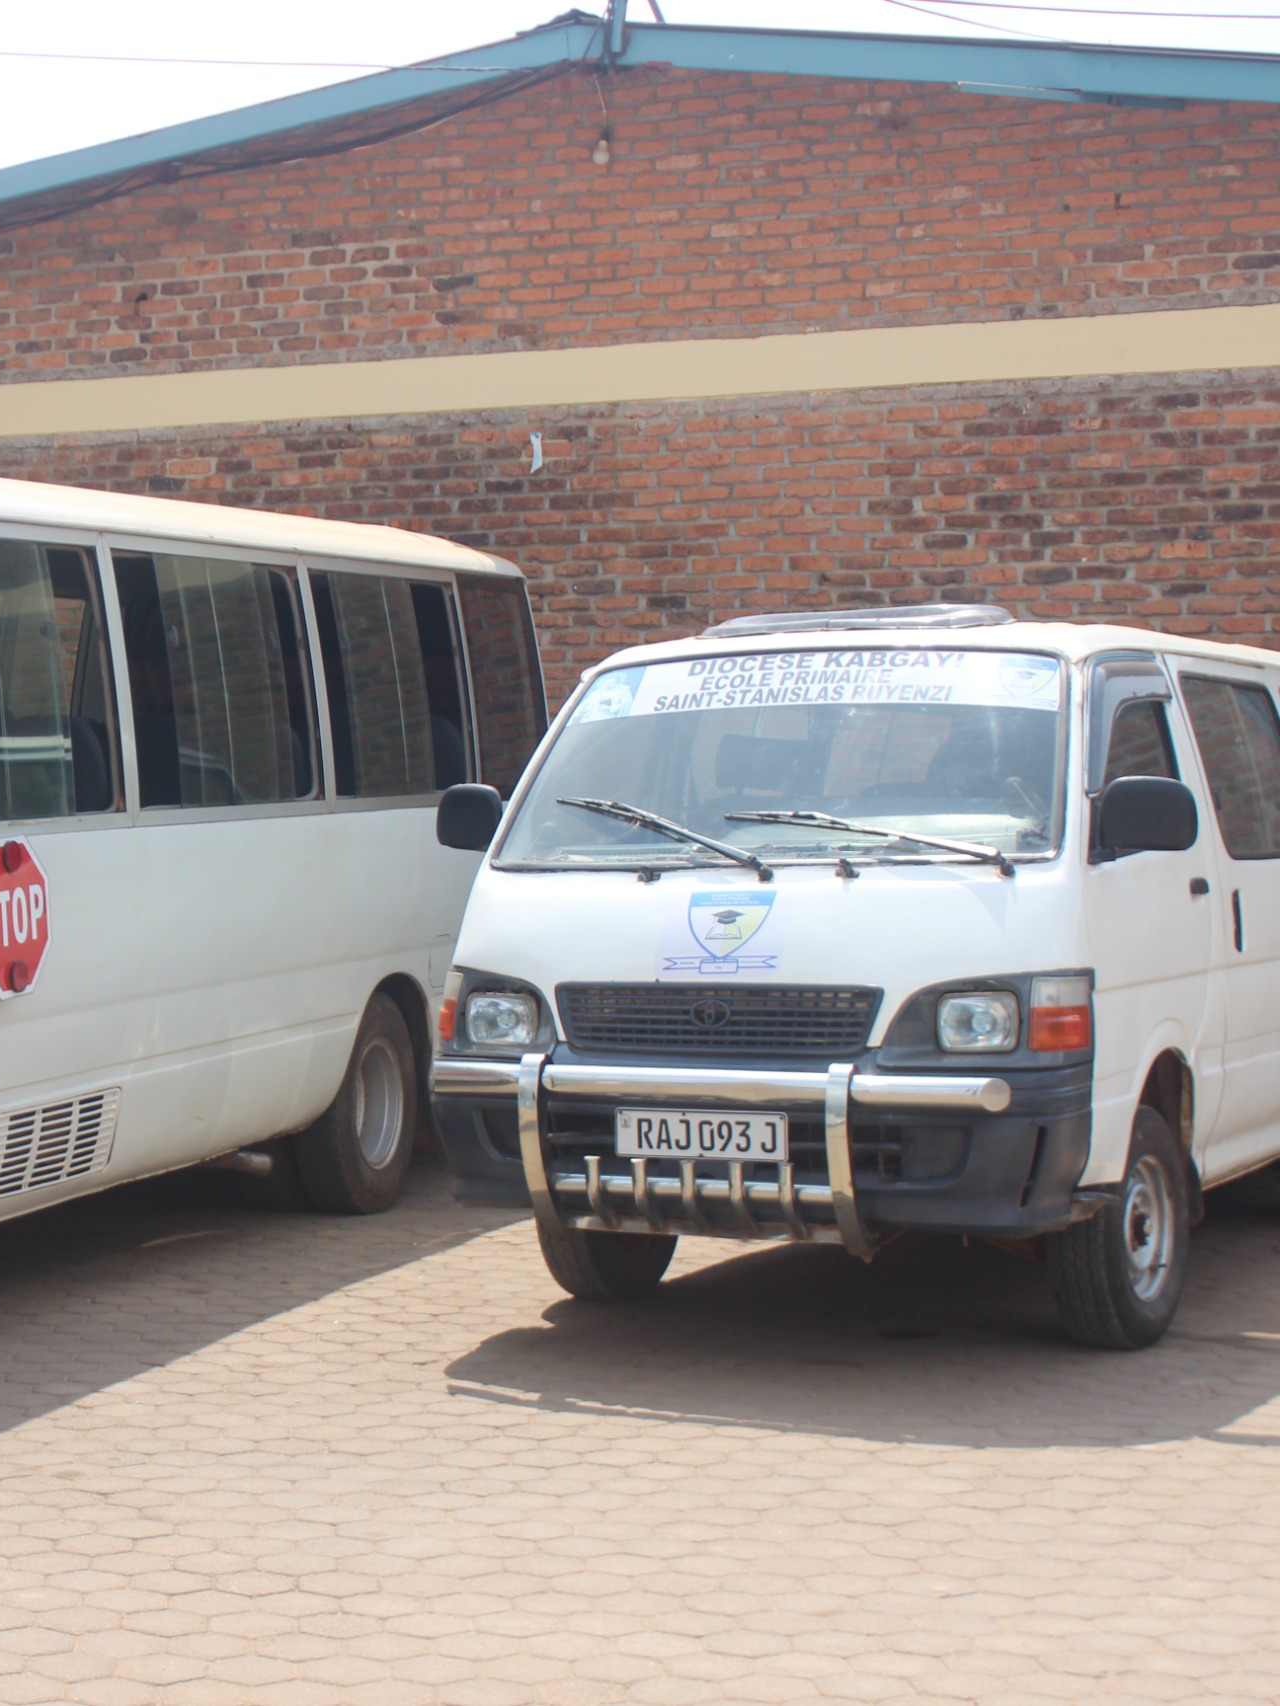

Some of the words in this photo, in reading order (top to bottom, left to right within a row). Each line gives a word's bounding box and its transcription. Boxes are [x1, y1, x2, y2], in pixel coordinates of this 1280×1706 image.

[688, 653, 816, 677] DIOCESE
[823, 651, 965, 668] KABGAYI
[699, 672, 774, 691] ECOLE
[779, 668, 894, 686] PRIMAIRE
[653, 685, 845, 712] SAINT-STANISLAS
[850, 684, 953, 702] RUYENZI
